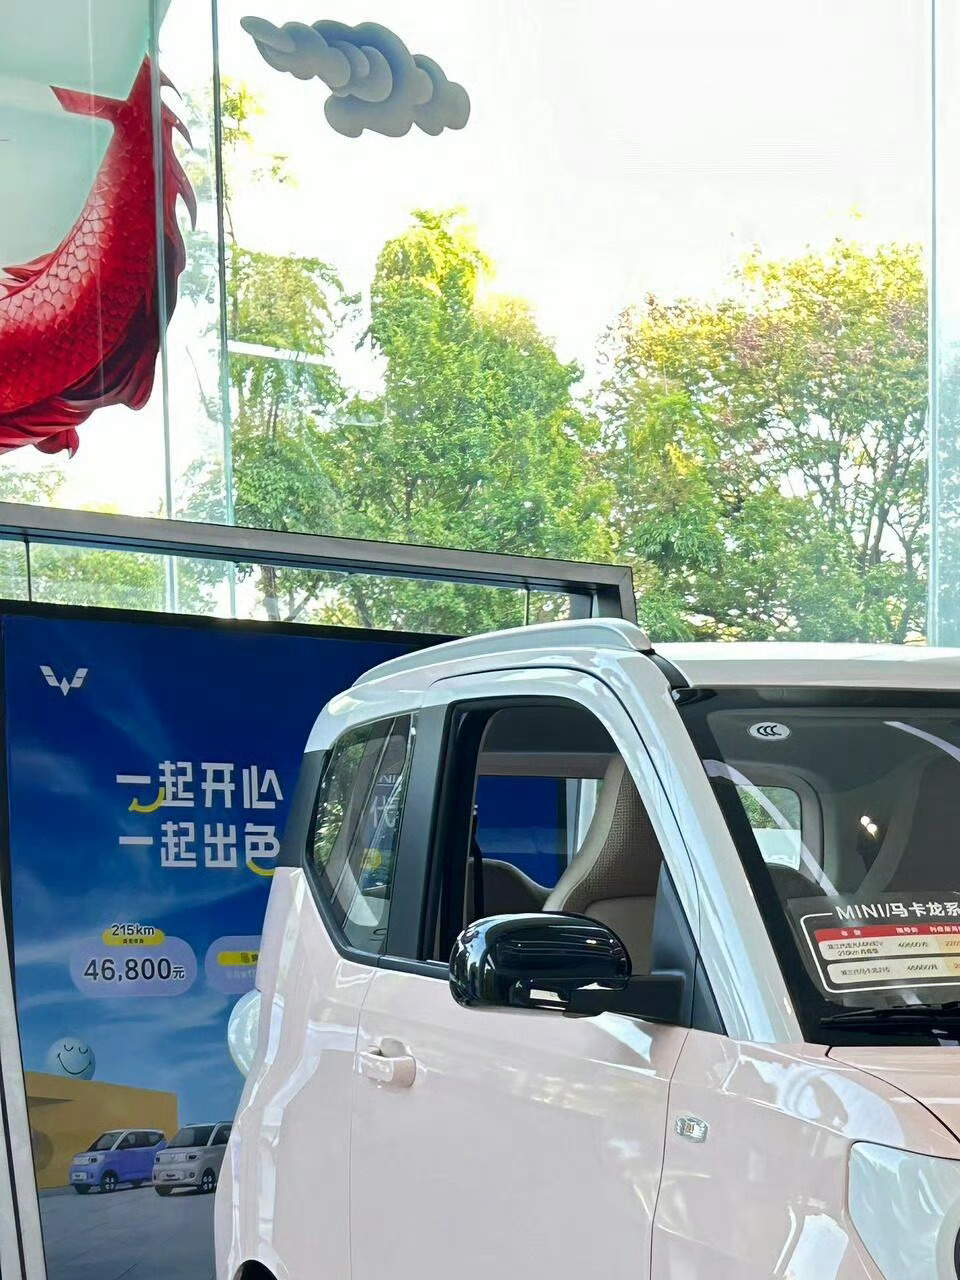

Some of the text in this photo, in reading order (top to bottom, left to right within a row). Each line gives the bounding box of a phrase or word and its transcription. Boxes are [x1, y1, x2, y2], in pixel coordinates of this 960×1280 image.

[116, 760, 284, 811] 一起开心
[119, 821, 281, 876] 一起出色
[111, 924, 155, 937] 215km
[84, 958, 185, 982] 46,800元
